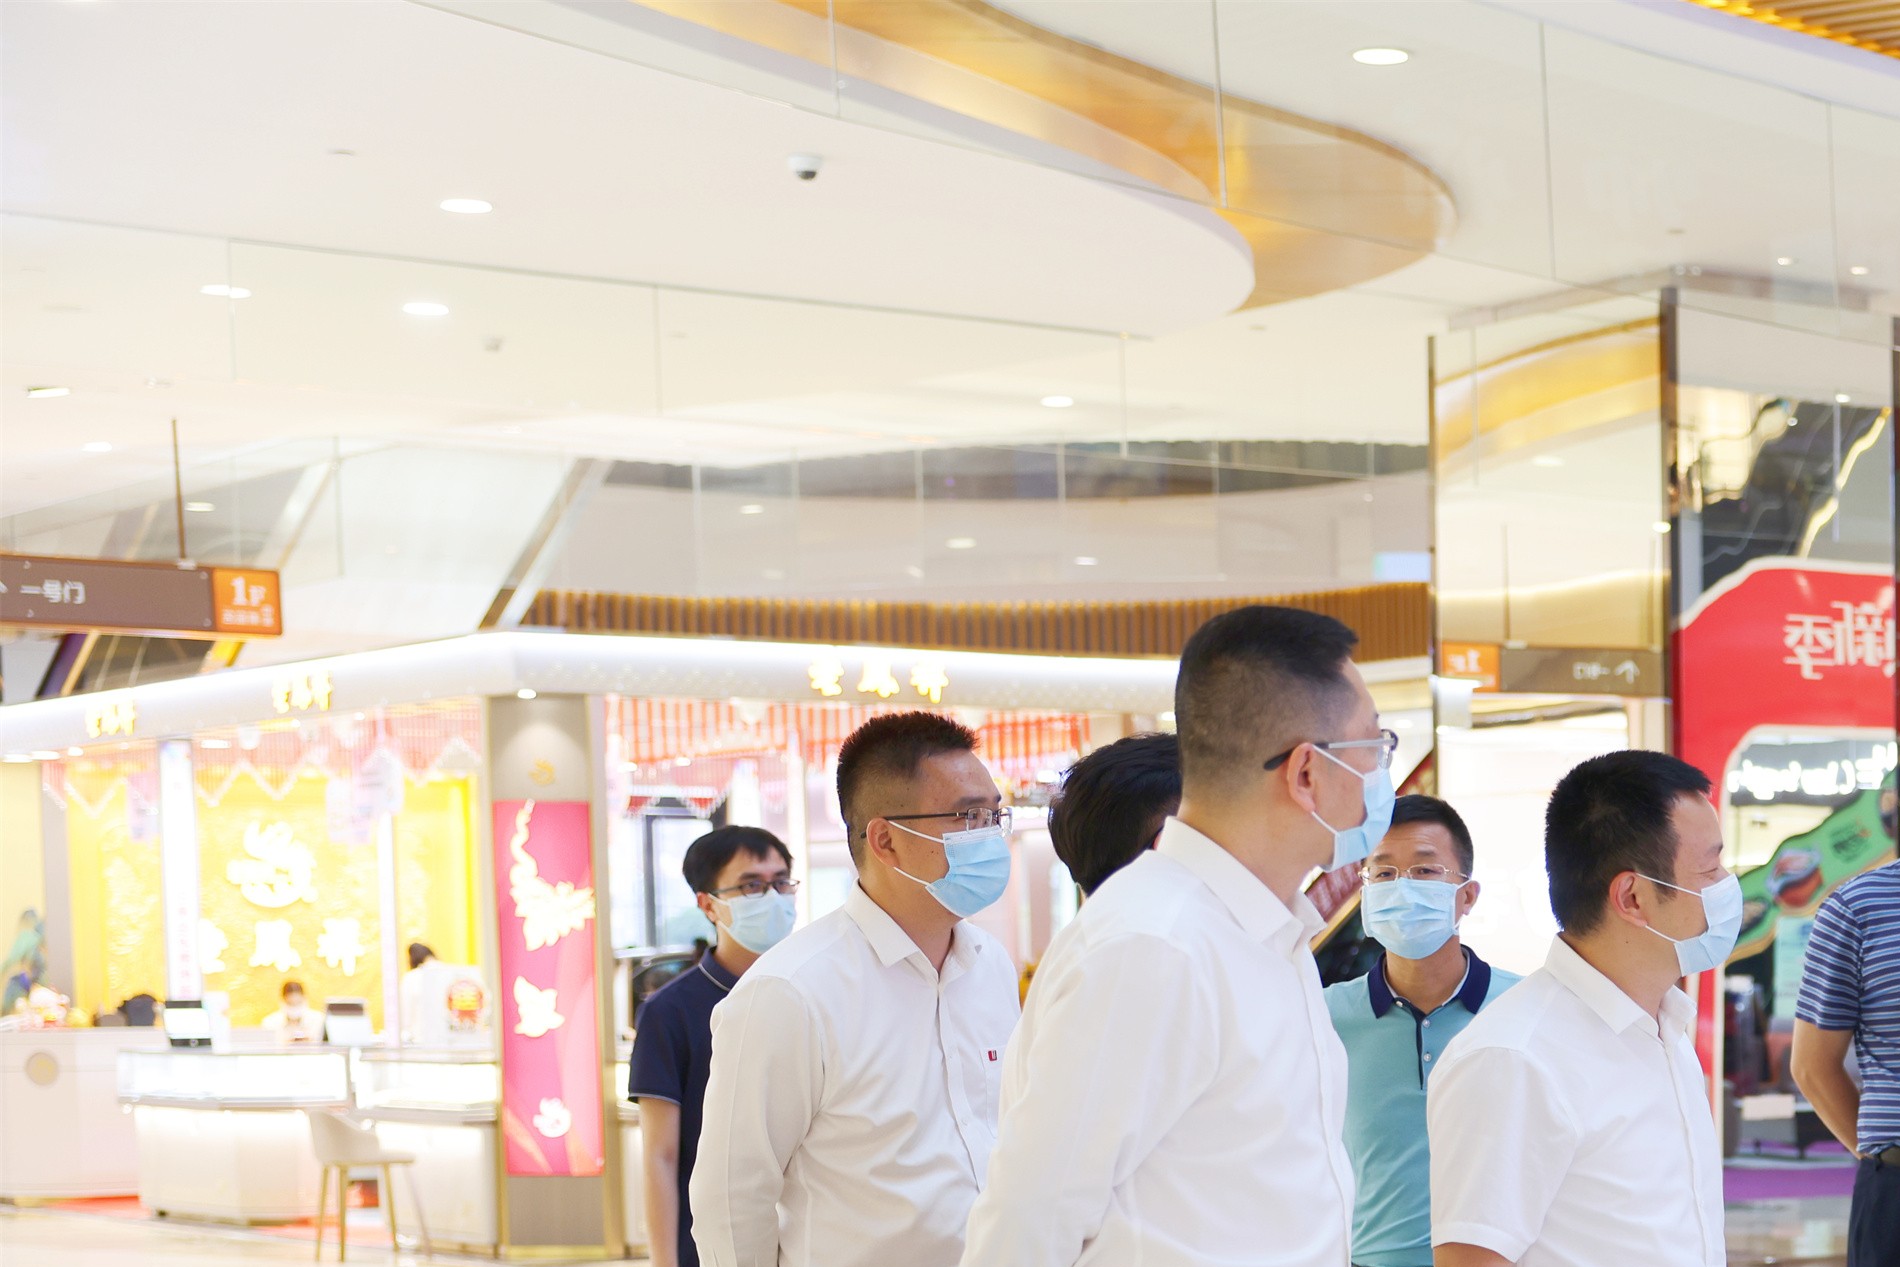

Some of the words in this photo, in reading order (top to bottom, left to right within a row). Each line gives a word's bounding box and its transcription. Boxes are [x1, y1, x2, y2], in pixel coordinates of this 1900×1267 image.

[19, 578, 86, 605] 一号门
[230, 576, 267, 607] 1F
